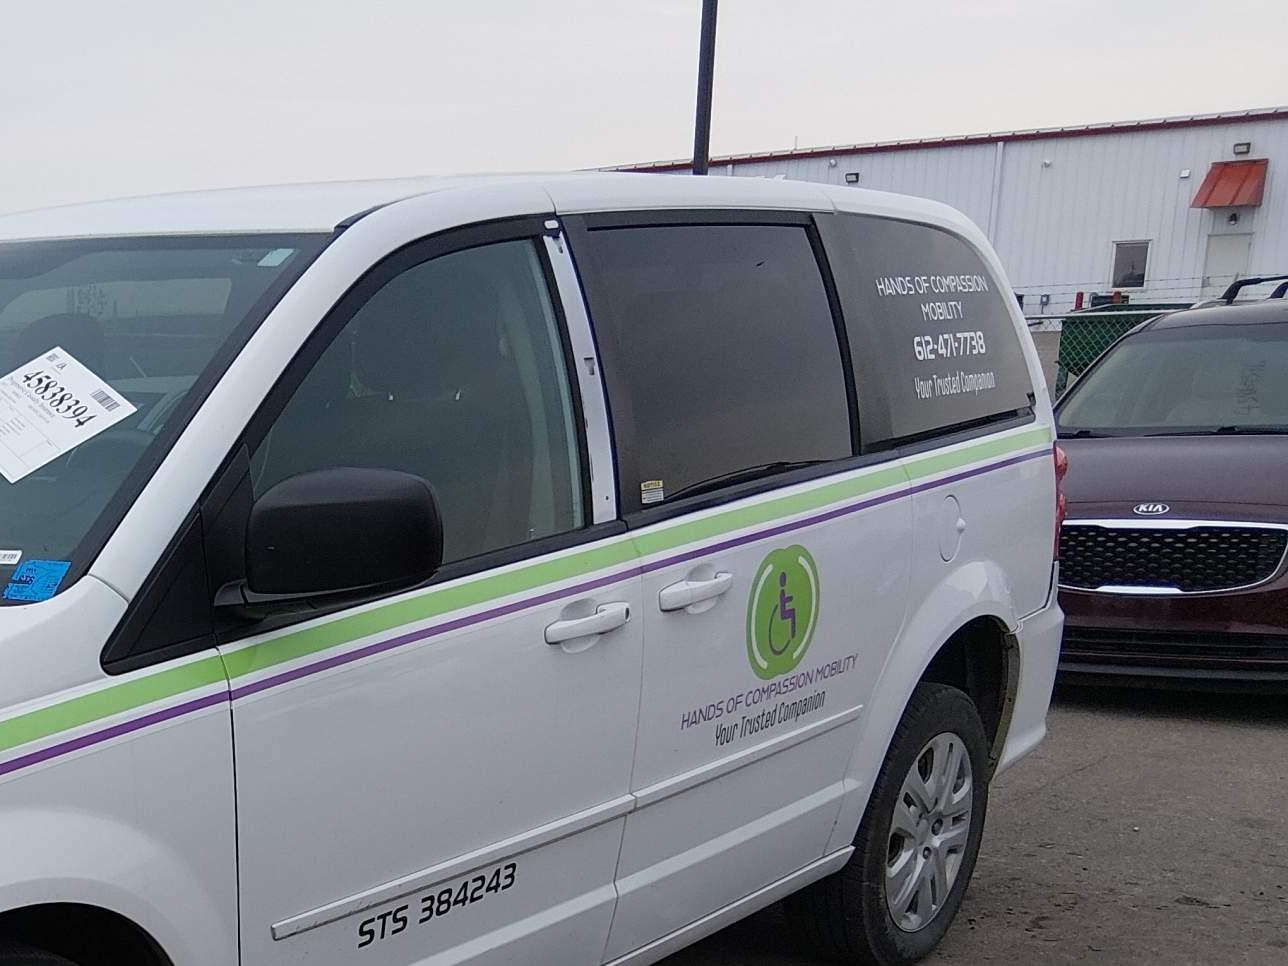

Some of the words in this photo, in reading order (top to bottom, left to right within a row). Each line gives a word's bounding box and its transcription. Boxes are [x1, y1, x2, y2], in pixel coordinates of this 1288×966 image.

[876, 276, 914, 297] HANDS
[915, 276, 930, 294] OF
[930, 275, 989, 293] COMPASSION
[921, 302, 964, 321] MOBILITY
[913, 331, 986, 361] 612-471-7738
[22, 370, 97, 429] 45838394
[914, 376, 932, 399] Your
[933, 371, 961, 397] Trusted
[960, 371, 996, 396] Companion
[681, 700, 724, 731] HANDS
[726, 693, 745, 714] OF
[745, 672, 813, 707] COMPASSION
[814, 653, 859, 682] MOBILITY
[715, 722, 738, 747] Your
[740, 703, 777, 738] Trusted
[777, 690, 826, 725] Companion
[358, 904, 409, 949] STS
[418, 862, 517, 925] 384243
